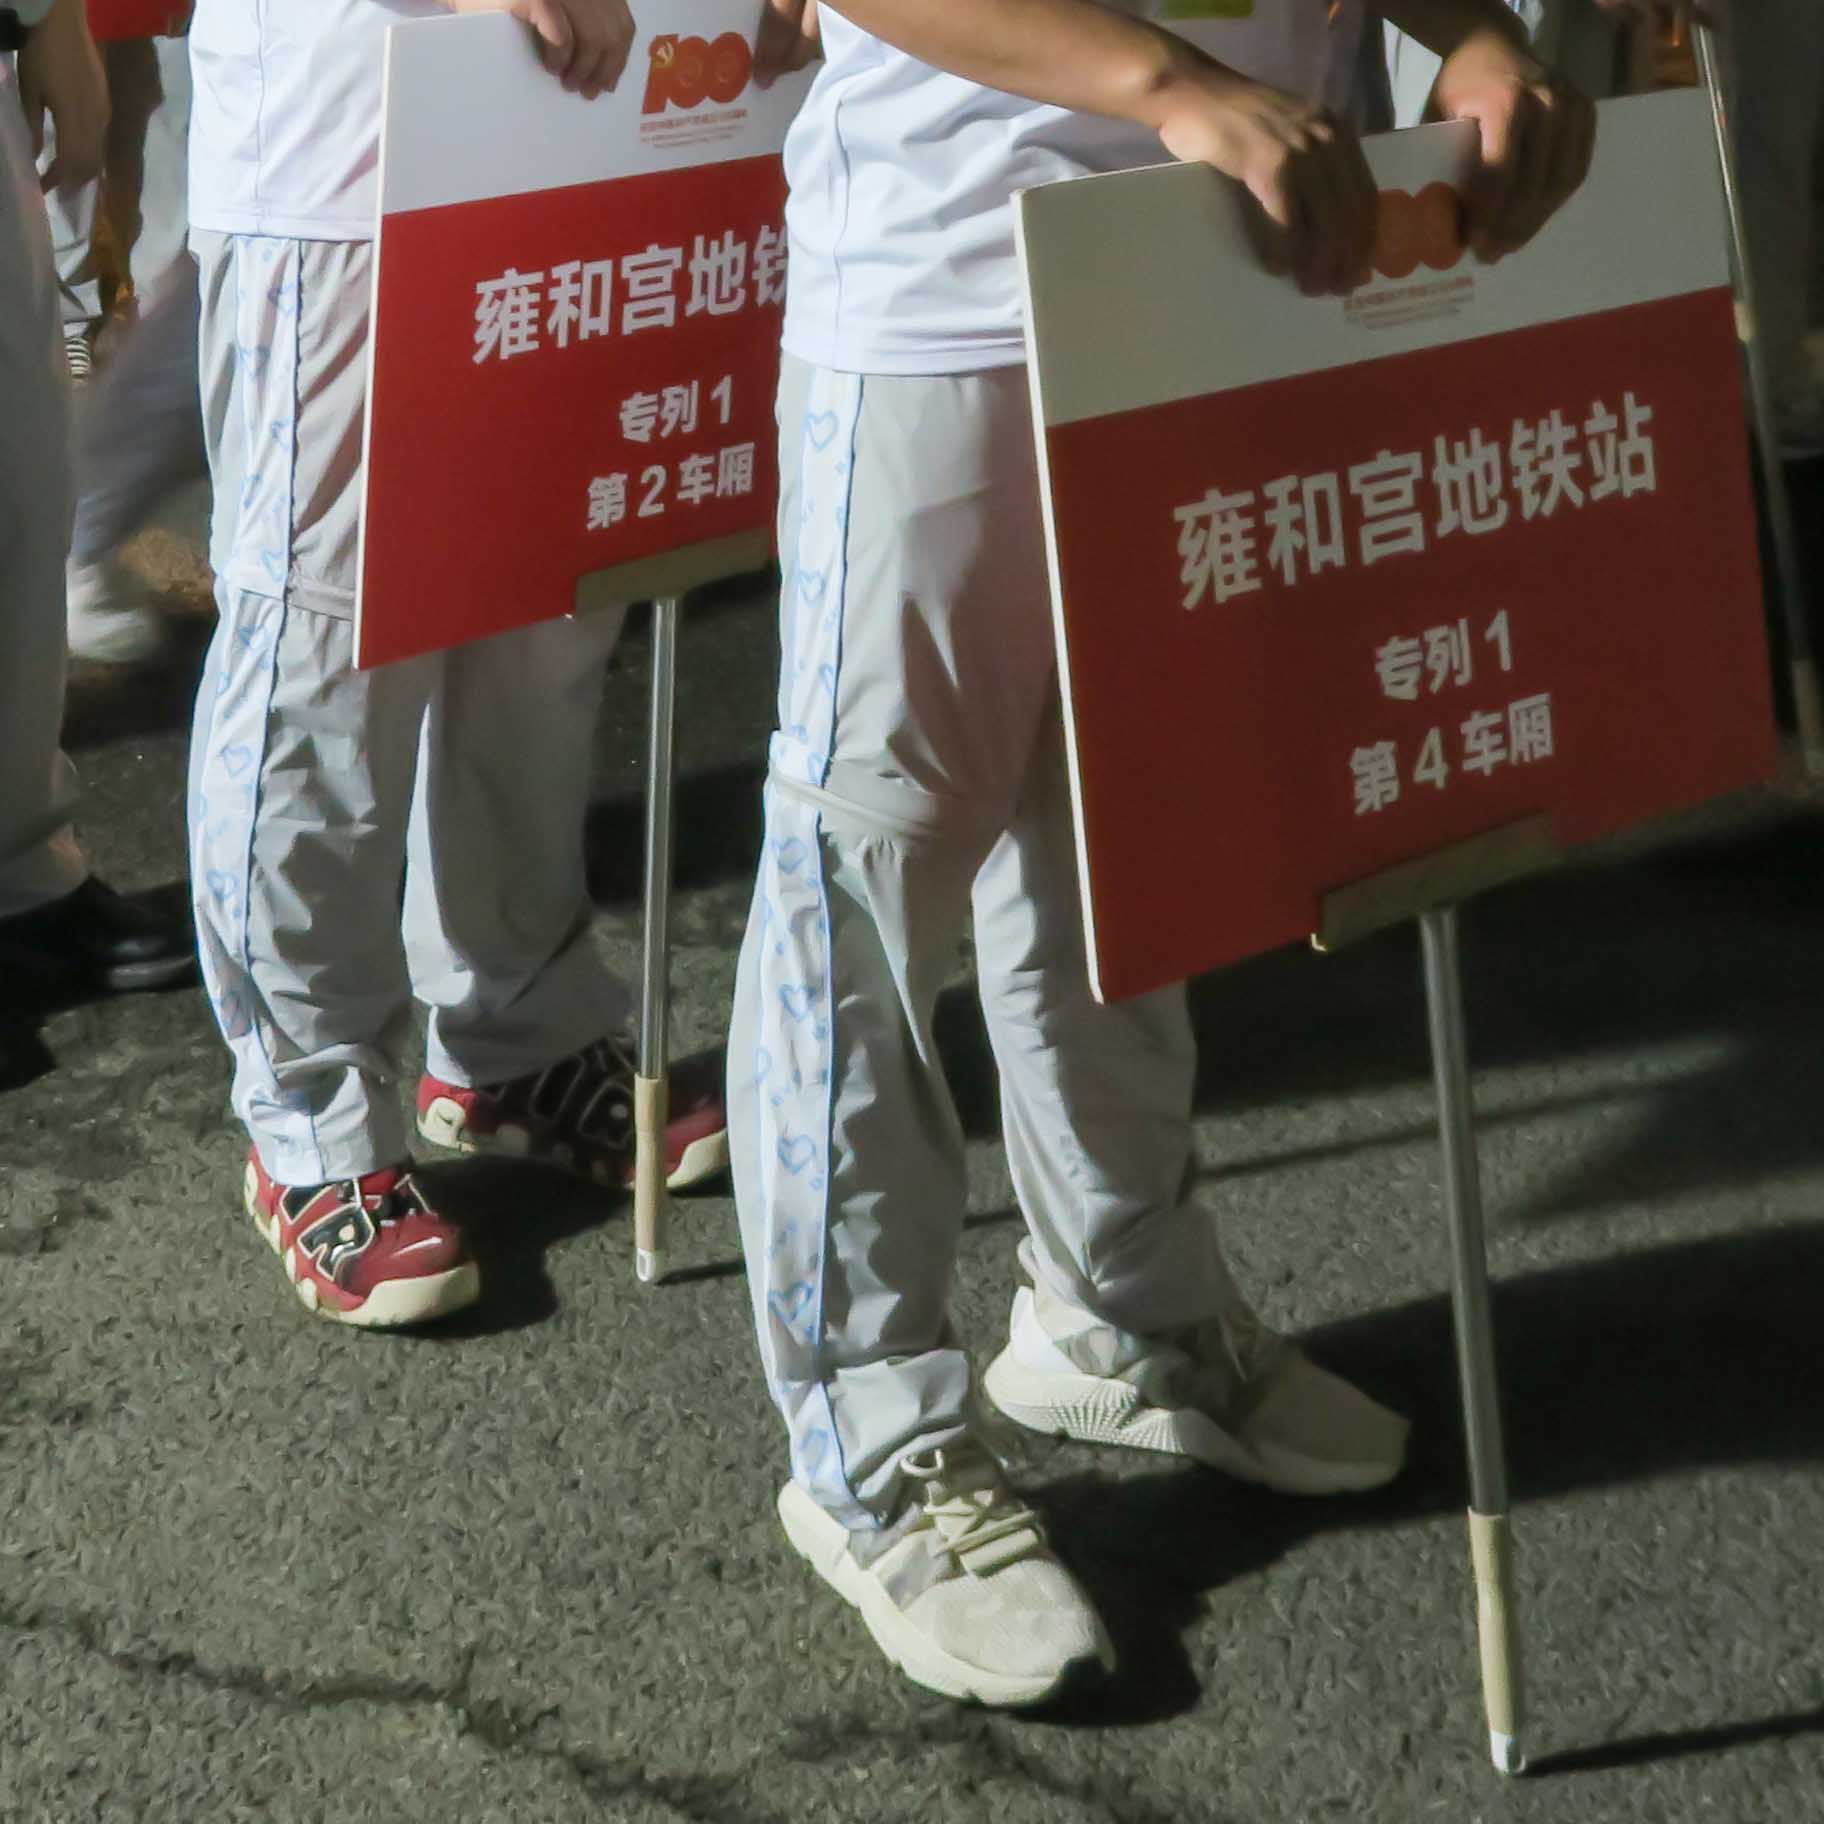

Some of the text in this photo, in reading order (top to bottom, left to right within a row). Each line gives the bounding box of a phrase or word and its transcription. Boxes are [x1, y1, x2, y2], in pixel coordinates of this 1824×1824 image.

[1173, 392, 1656, 611] 雍和宫地铁站
